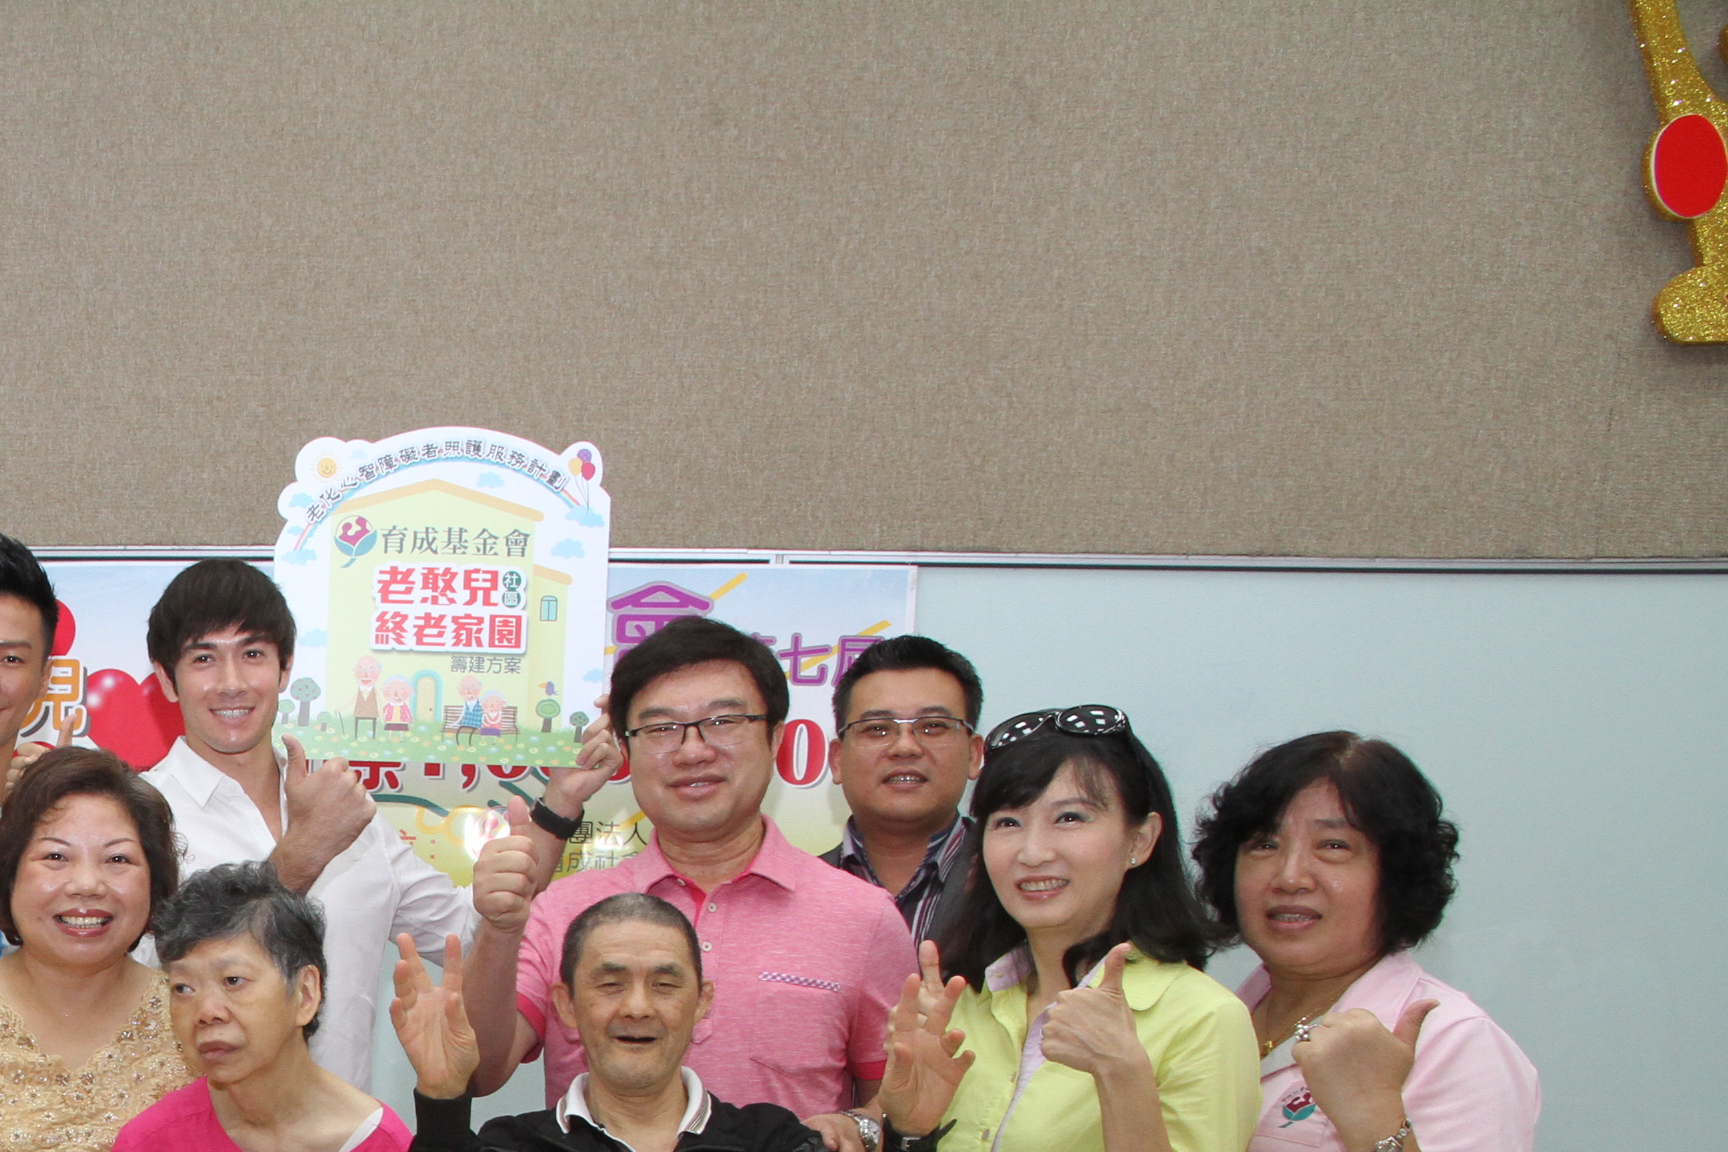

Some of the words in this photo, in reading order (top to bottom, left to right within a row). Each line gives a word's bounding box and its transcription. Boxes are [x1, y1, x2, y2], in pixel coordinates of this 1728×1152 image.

[306, 439, 570, 524] 老化心智障礙者照護服務計劃
[381, 525, 532, 558] 育成基金會
[376, 566, 500, 608] 老憨兒
[503, 571, 522, 607] 社區
[375, 611, 523, 649] 終老家園
[450, 655, 522, 675] 籌建方案
